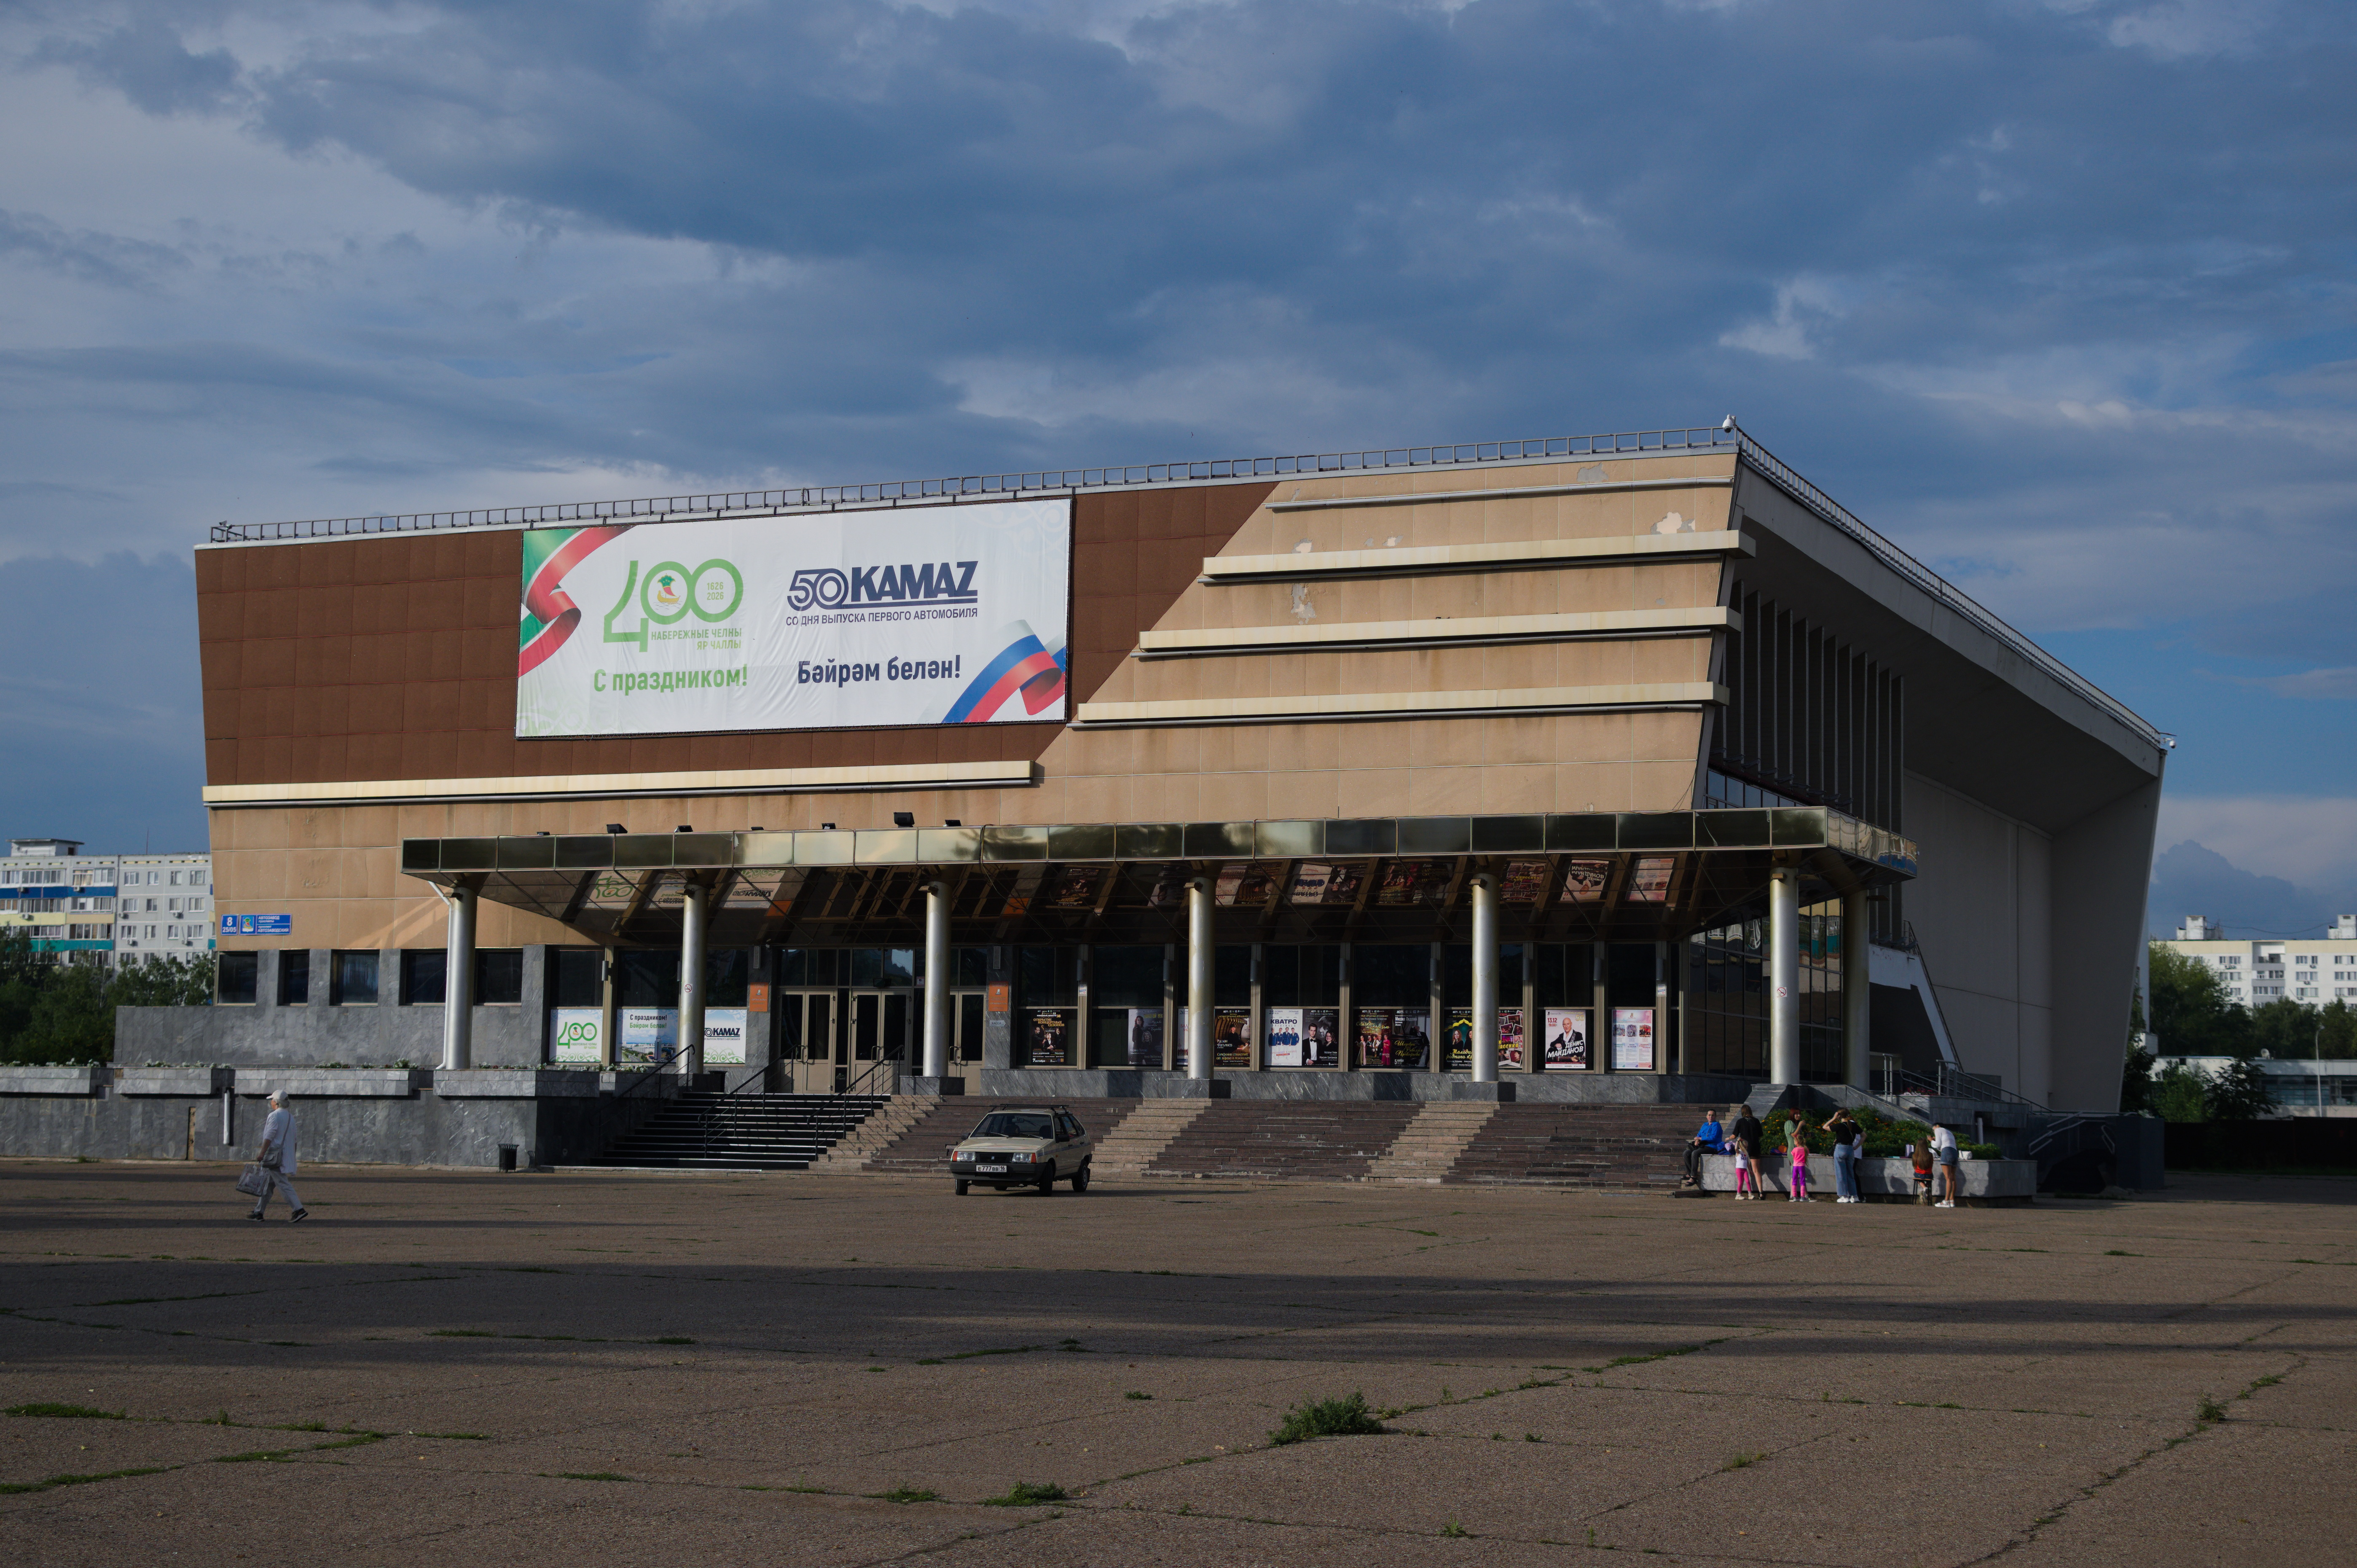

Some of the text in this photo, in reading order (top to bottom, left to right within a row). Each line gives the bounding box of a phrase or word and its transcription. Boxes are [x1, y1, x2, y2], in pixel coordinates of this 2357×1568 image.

[707, 582, 724, 590] 1626
[787, 561, 978, 611] 50 KAMAZ
[707, 592, 724, 600] 2026
[603, 558, 744, 652] 400
[786, 608, 977, 627] СО ДНЯ ВЫПУСКА ПЕРВОГО АВТОМОБИЛЯ
[651, 628, 742, 640] НАБЕРЕЖНЫЕ ЧЕЛНЫ
[697, 639, 741, 650] ЯР ЧАЛЛЫ
[798, 655, 960, 688] Бәйрәм белән!
[593, 664, 748, 696] С праздником!
[227, 917, 233, 926] 8
[634, 1014, 667, 1023] праздником!
[557, 1022, 597, 1049] 400
[713, 1028, 741, 1036] KAMAZ
[1565, 1040, 1584, 1049] ДЕНИС
